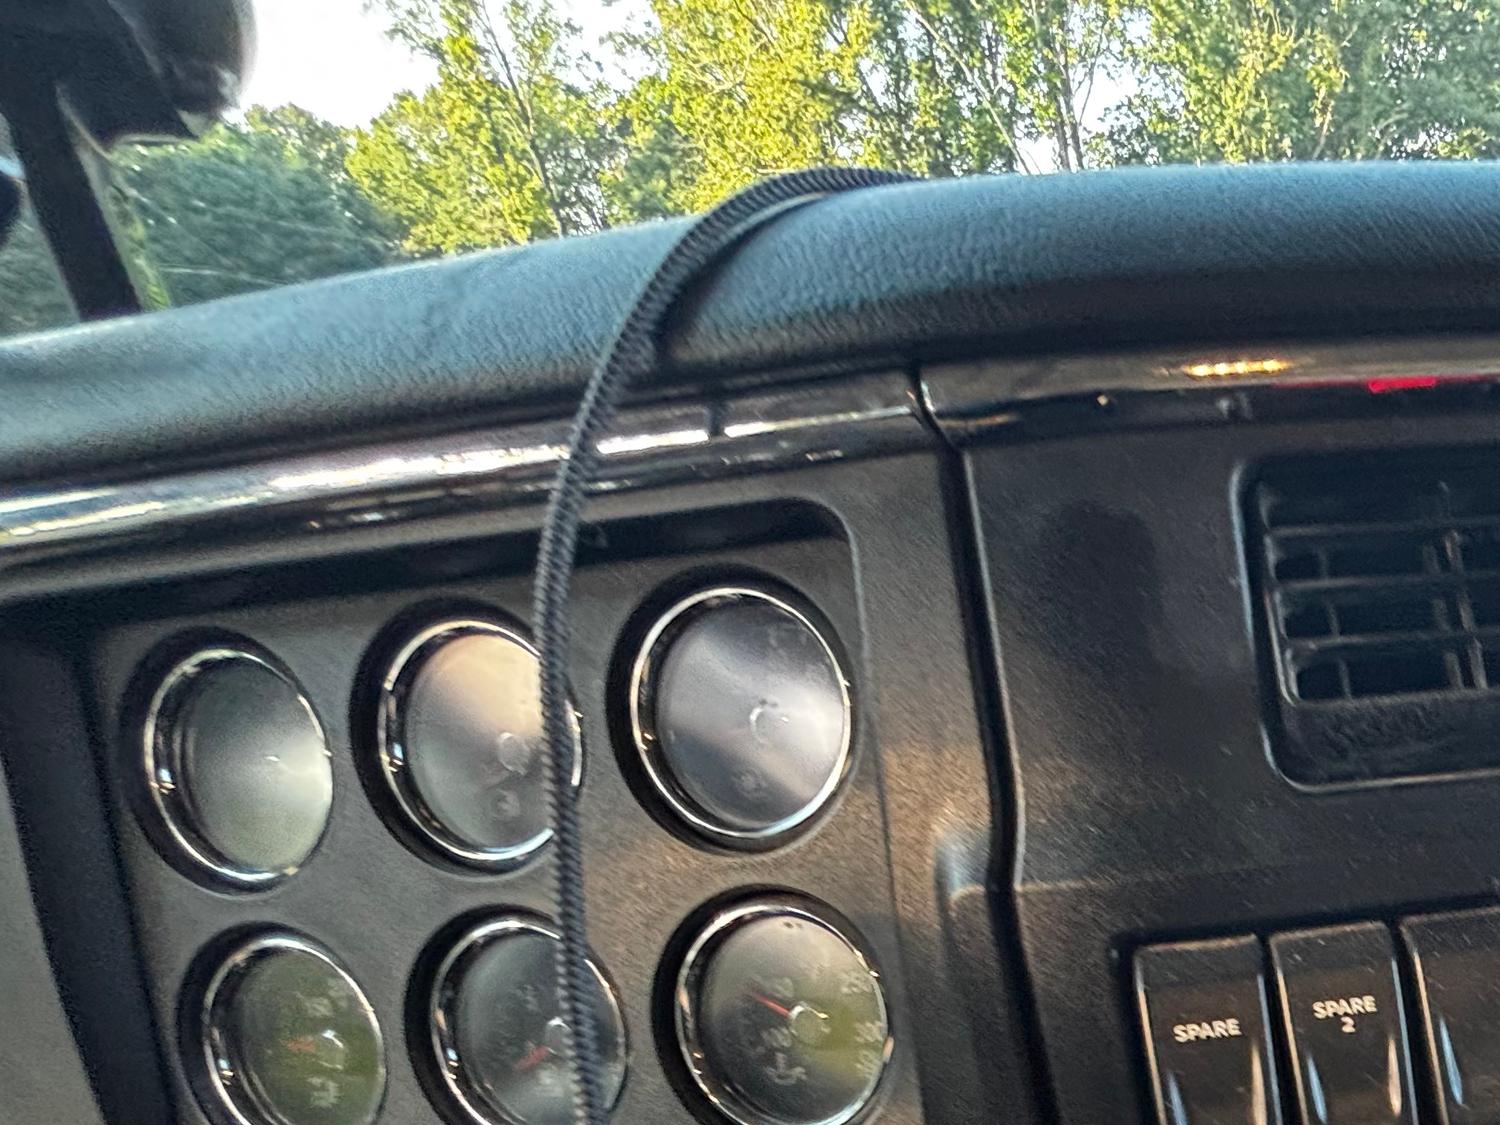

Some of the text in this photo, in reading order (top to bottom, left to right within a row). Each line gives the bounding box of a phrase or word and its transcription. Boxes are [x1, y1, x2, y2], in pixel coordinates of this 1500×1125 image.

[1312, 995, 1378, 1020] SPARE
[1172, 1017, 1243, 1043] SPARE
[1340, 1016, 1357, 1034] 2
